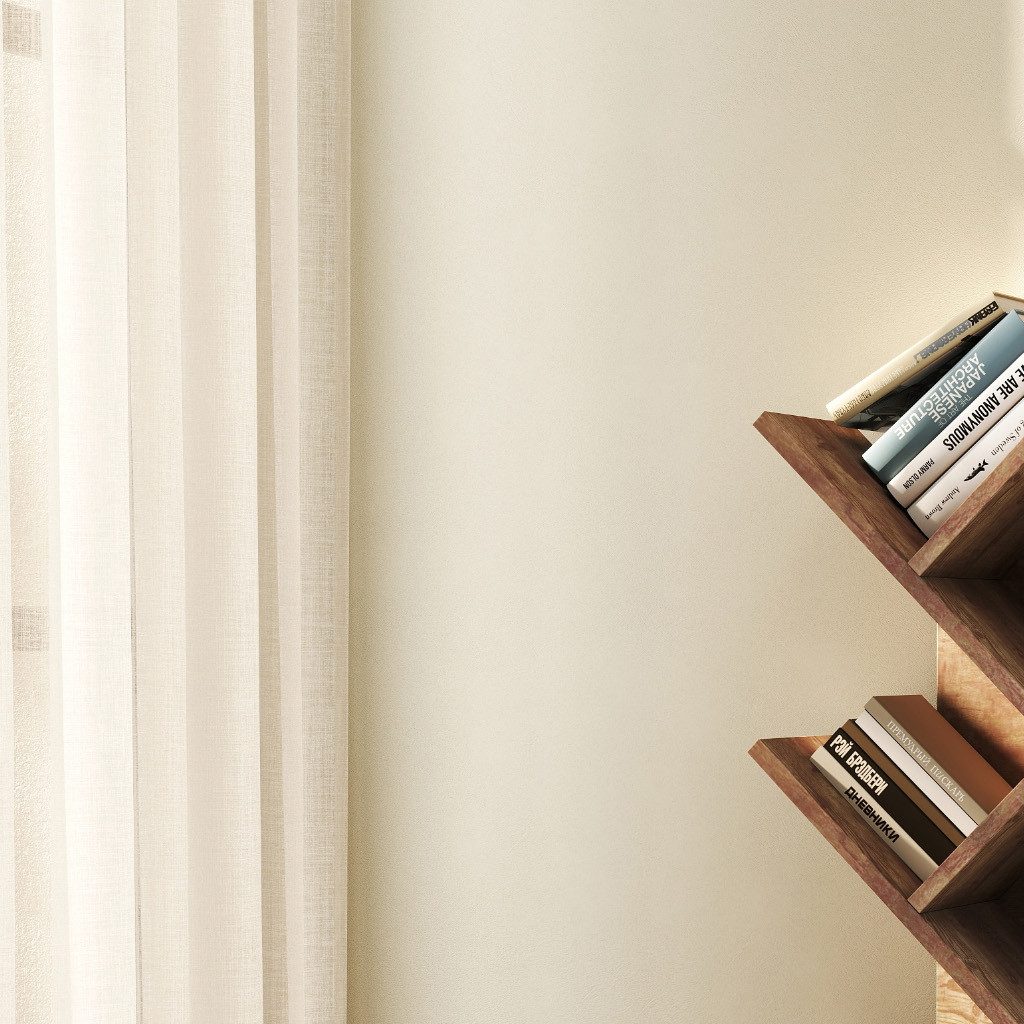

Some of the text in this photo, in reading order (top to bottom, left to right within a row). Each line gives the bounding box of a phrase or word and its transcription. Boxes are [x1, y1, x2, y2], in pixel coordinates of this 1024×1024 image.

[968, 301, 998, 326] FRANK
[894, 352, 983, 440] ARCHITECTURE
[928, 362, 986, 422] JAPANESE
[996, 375, 1019, 400] ARE
[938, 394, 973, 428] THE ART OF
[942, 394, 1001, 451] ANONYMOUS
[991, 432, 1016, 456] Sweden
[1014, 425, 1024, 439] of
[902, 458, 935, 490] PARMY OLSON
[924, 486, 961, 520] Andrew Brown
[830, 734, 888, 796] РЭЙ БРЭДБЕРИ
[886, 720, 965, 802] ПРЕМУДРЫЙ ПИСКАРЬ
[844, 786, 900, 842] ДНЕВНИКИ
